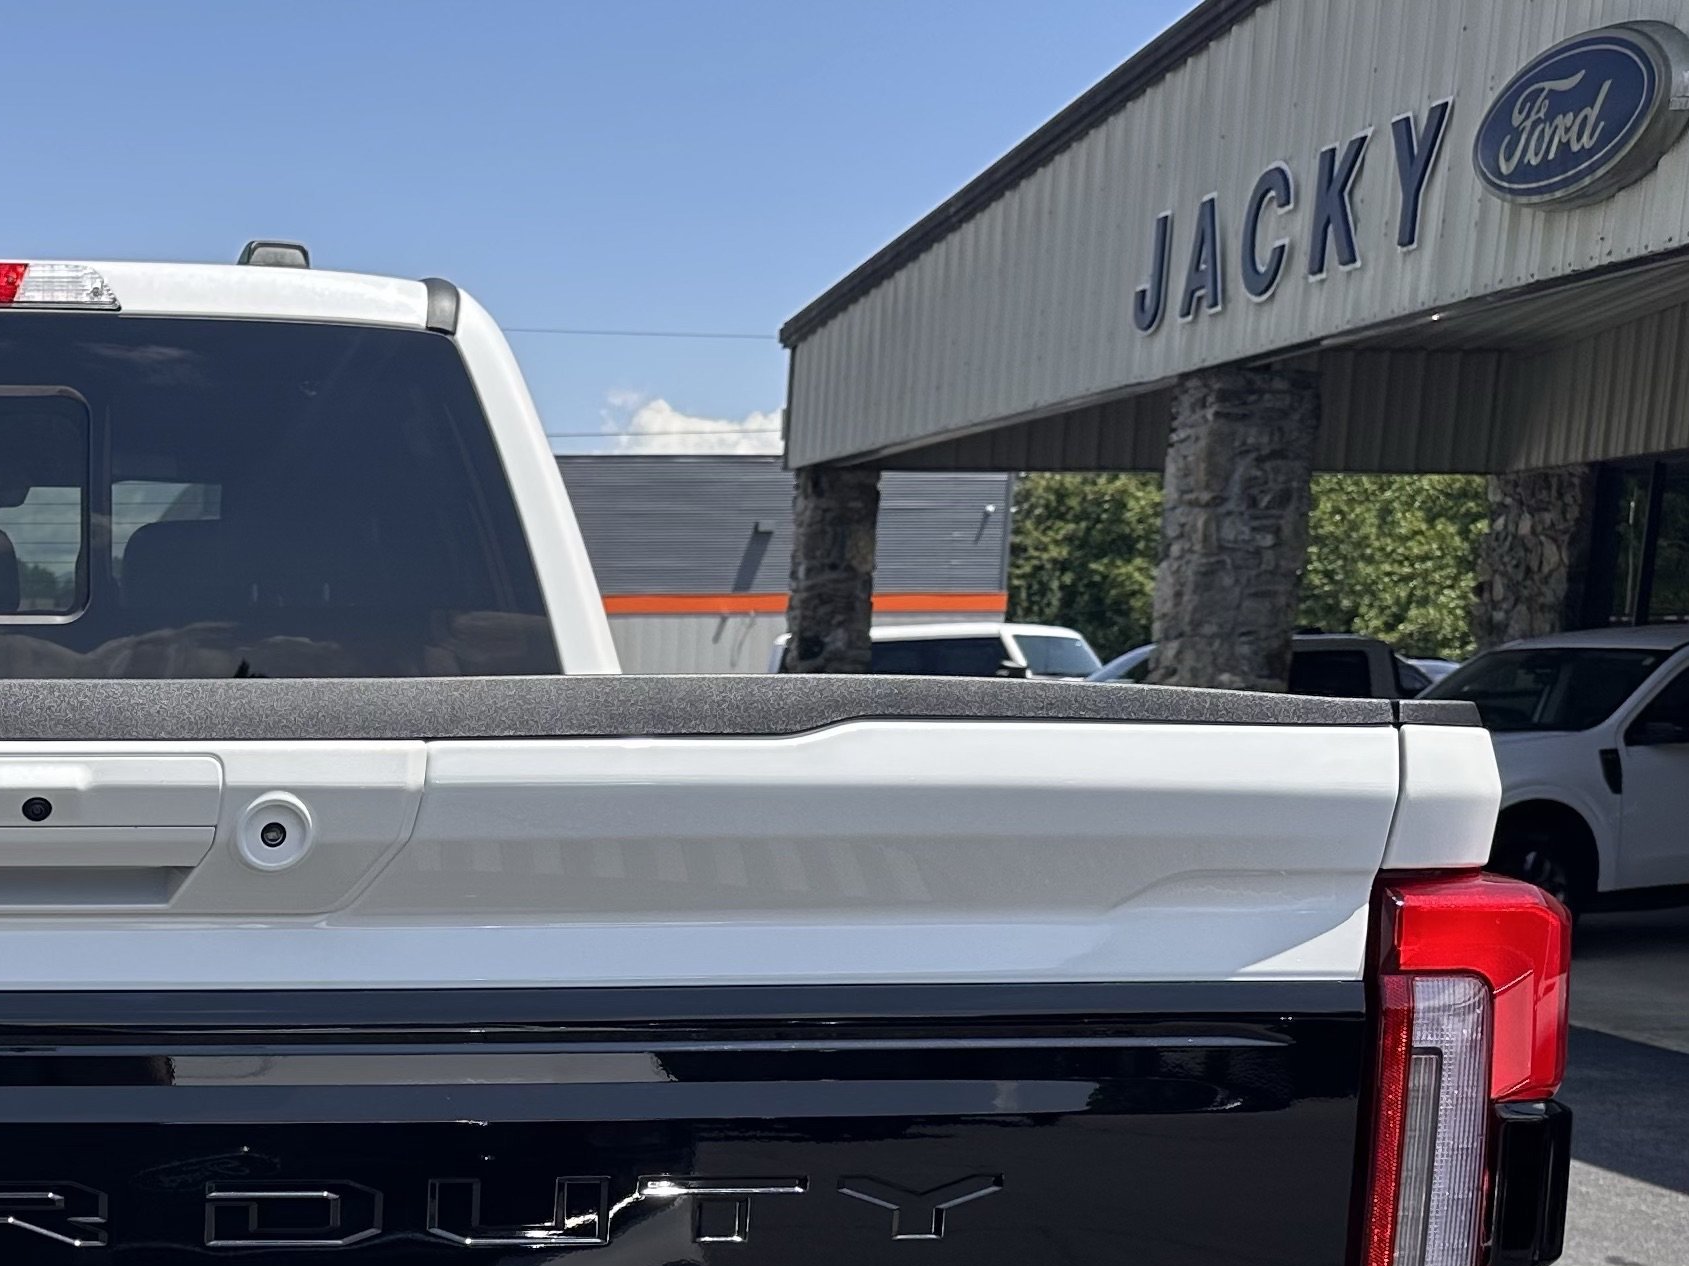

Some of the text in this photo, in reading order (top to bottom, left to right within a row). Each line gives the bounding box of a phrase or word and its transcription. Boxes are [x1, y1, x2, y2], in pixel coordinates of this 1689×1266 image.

[1499, 69, 1611, 176] Ford
[1132, 95, 1455, 337] JACKY
[205, 1173, 1006, 1248] DUTY
